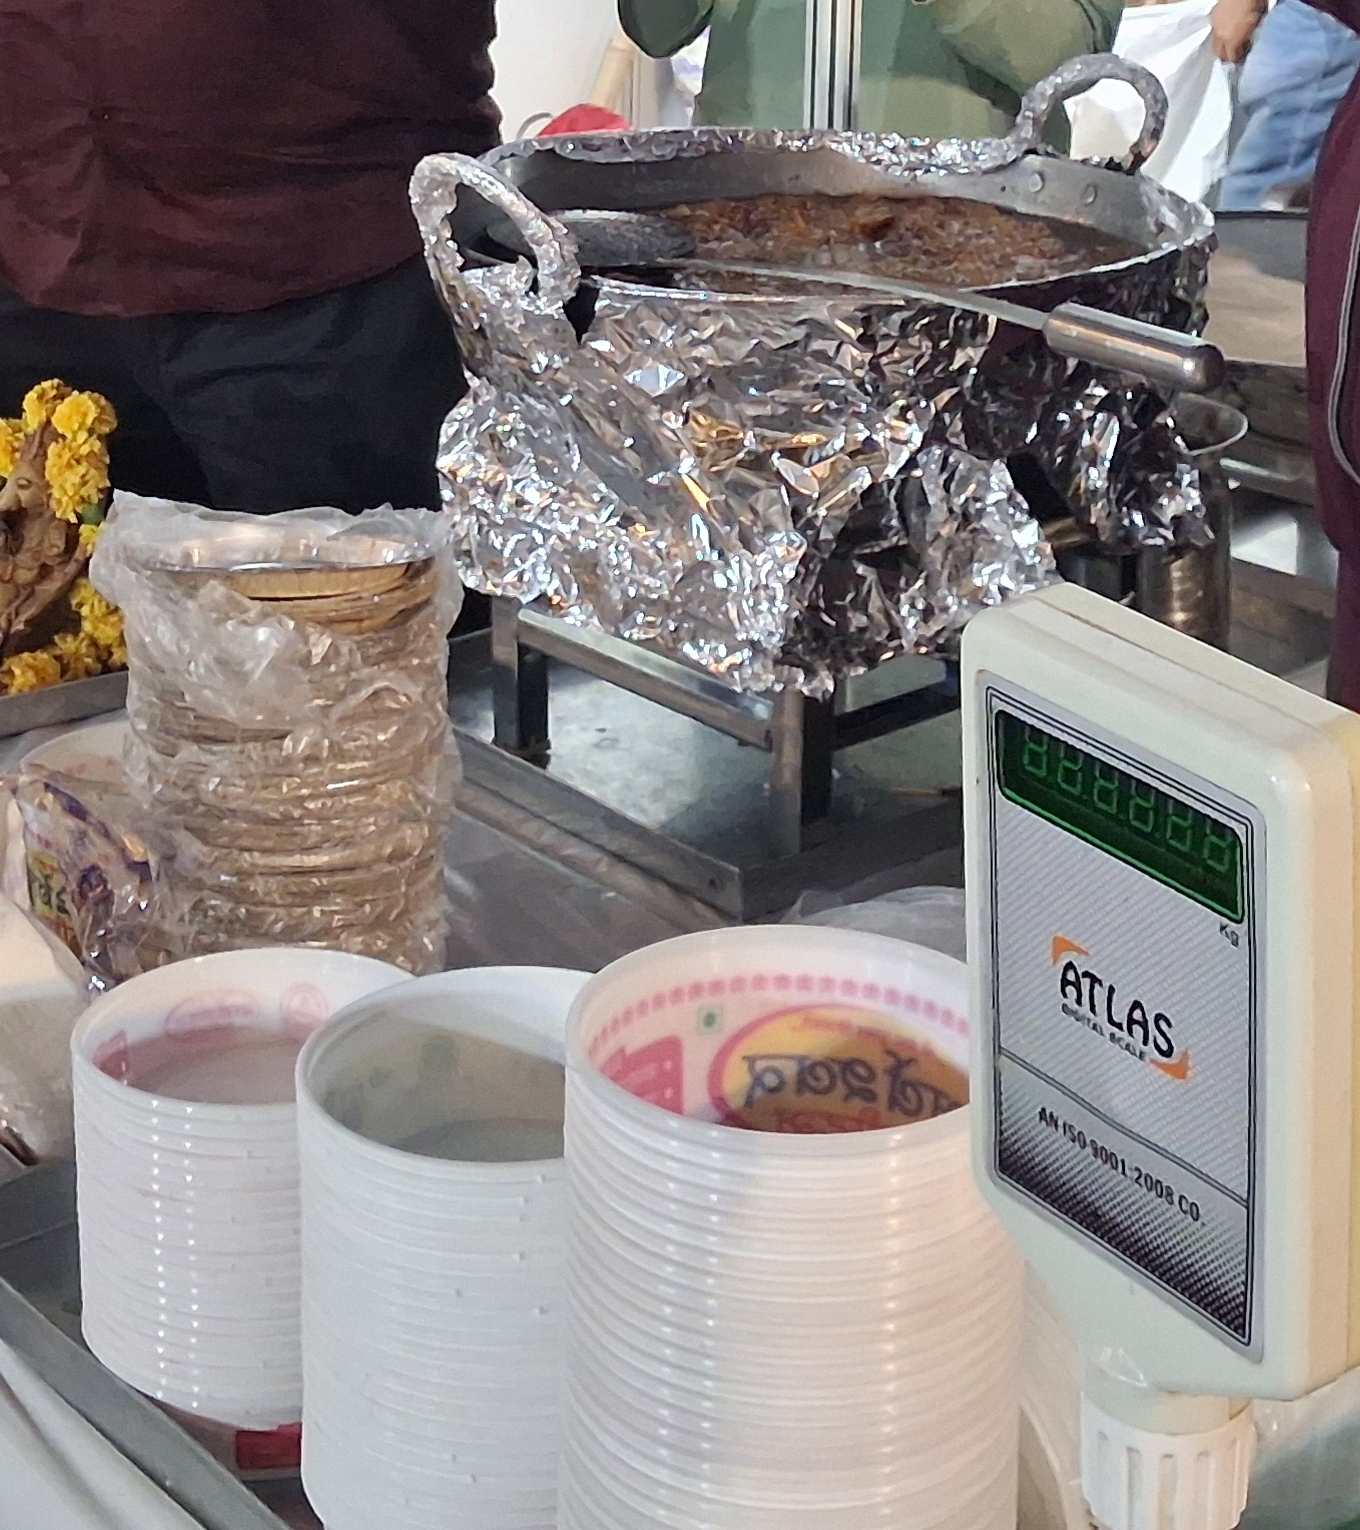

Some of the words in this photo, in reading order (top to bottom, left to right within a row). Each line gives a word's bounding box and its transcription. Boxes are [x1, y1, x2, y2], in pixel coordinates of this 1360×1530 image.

[1059, 960, 1175, 1059] ATLAS
[1038, 1106, 1059, 1131] AN
[1062, 1119, 1087, 1151] ISO
